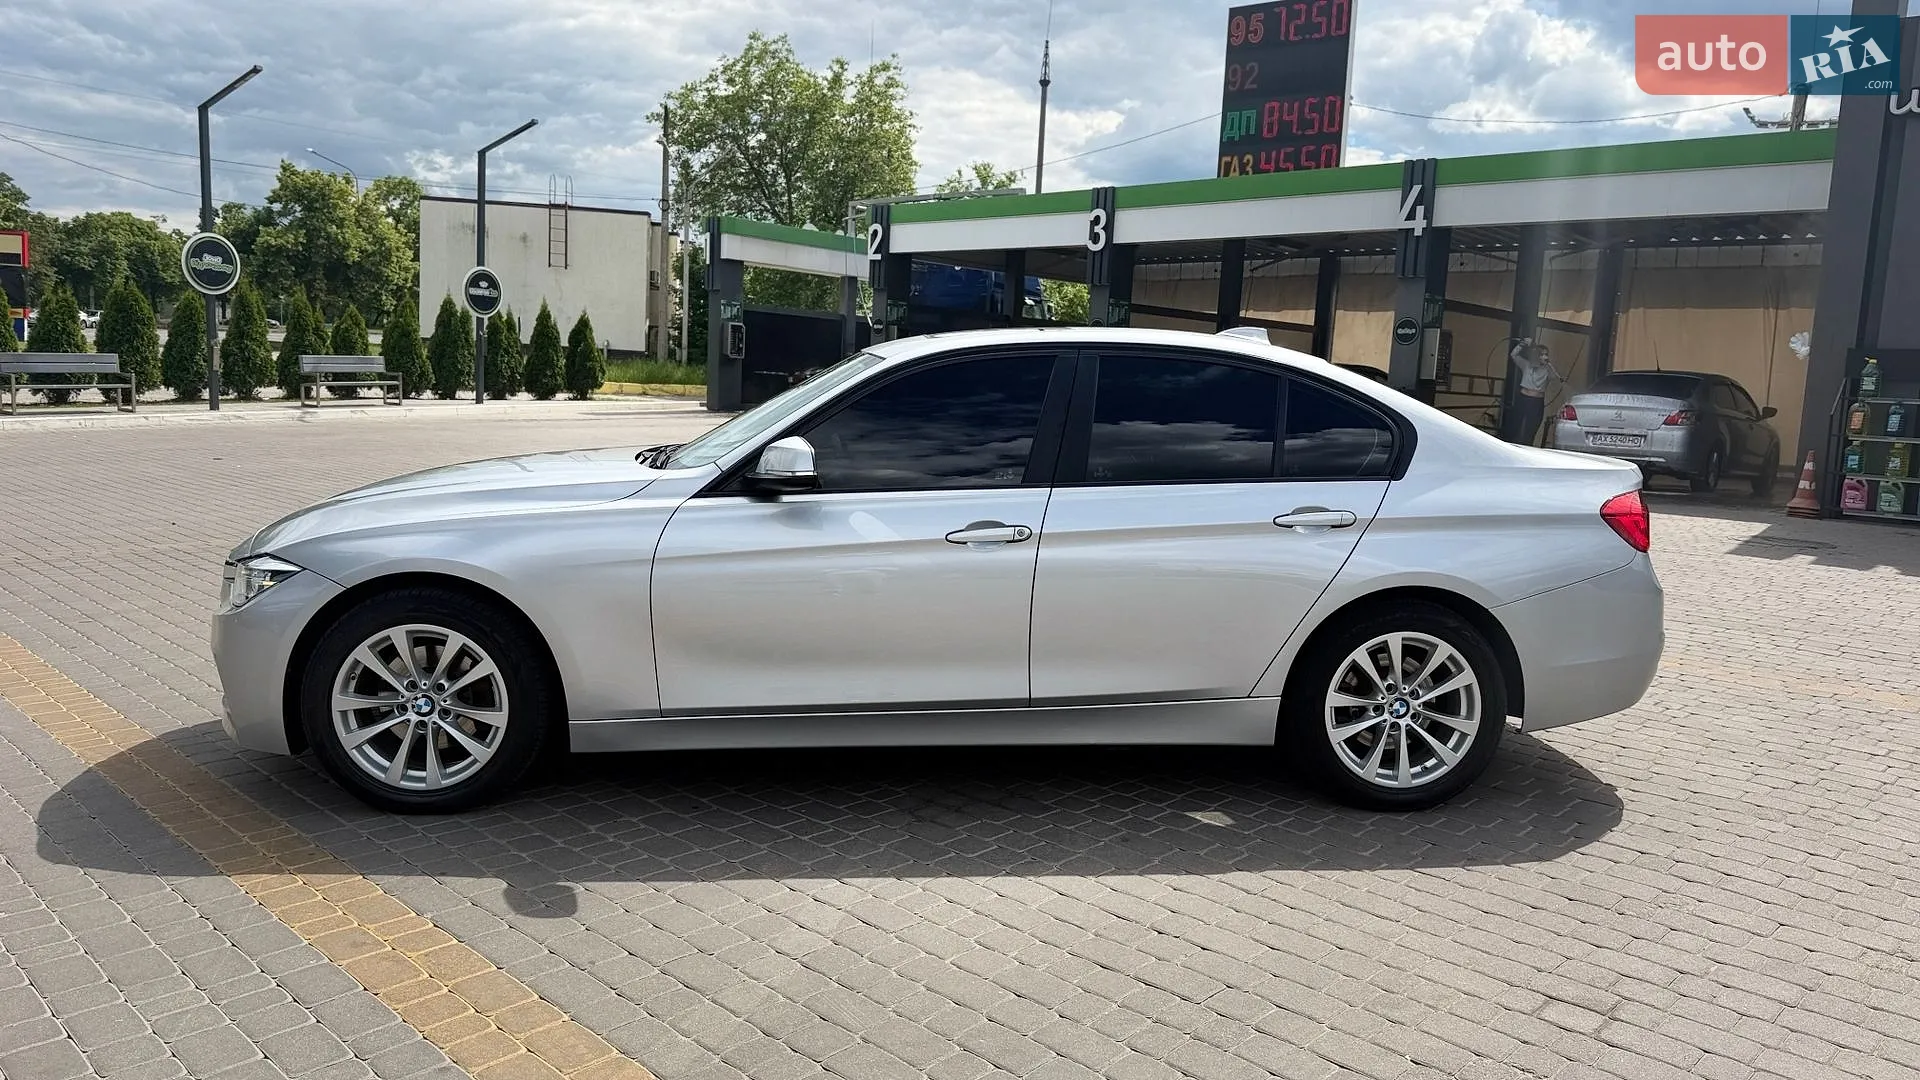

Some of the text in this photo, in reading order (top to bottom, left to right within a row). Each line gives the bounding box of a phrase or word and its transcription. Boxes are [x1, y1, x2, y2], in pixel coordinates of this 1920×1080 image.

[1230, 13, 1264, 46] 95
[1228, 62, 1259, 91] 92
[1223, 109, 1257, 142] ДП
[1220, 154, 1254, 178] ГАЗ
[1399, 184, 1428, 236] 4
[868, 223, 883, 260] 2
[1087, 208, 1107, 251] 3
